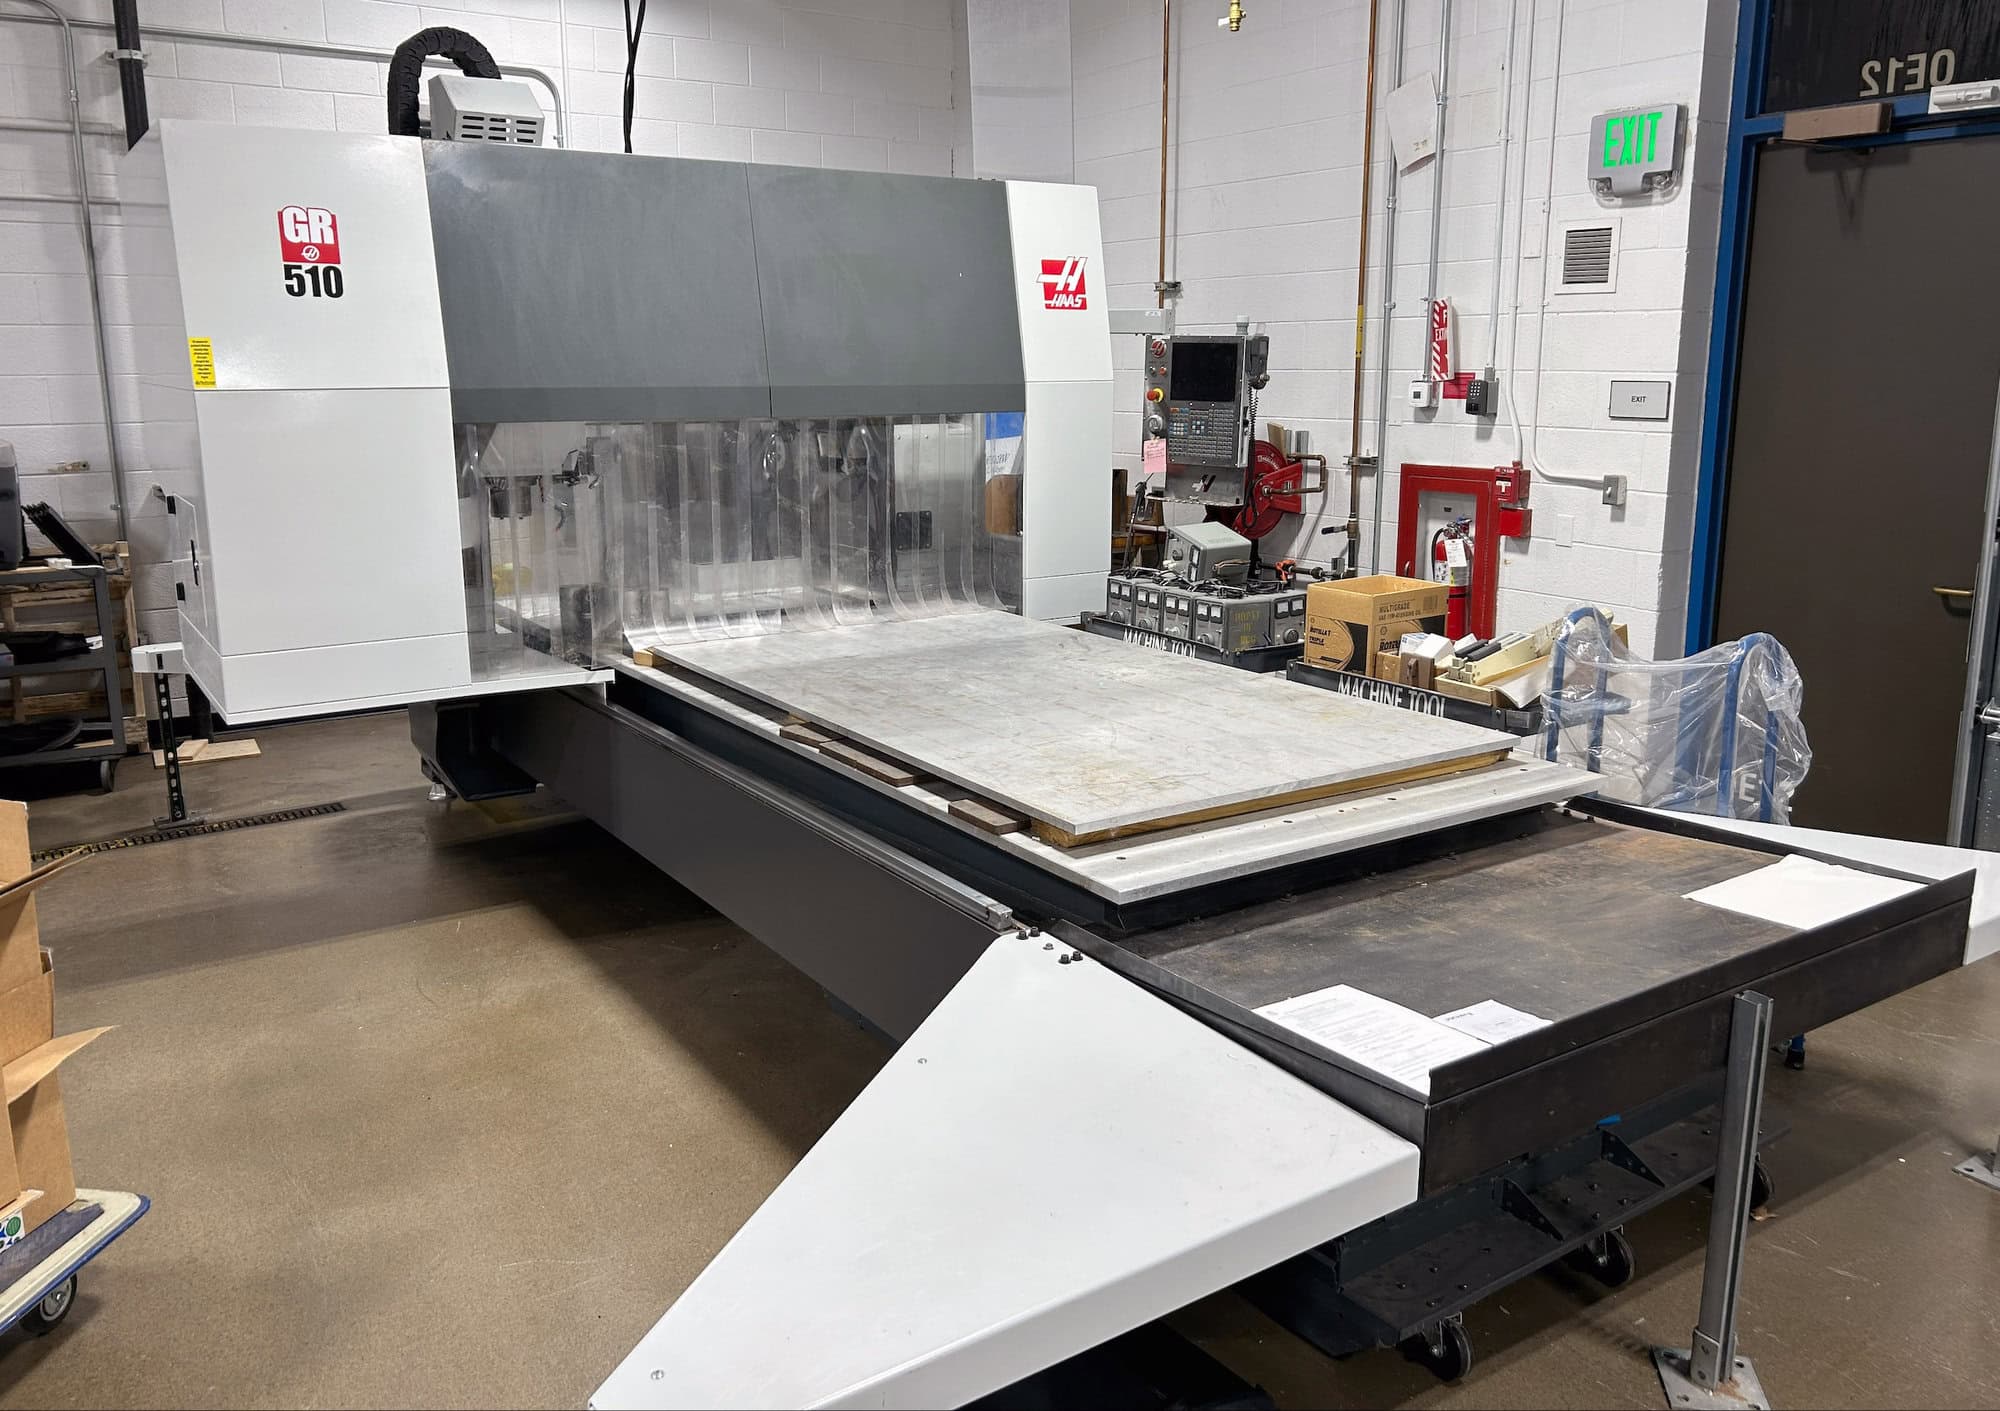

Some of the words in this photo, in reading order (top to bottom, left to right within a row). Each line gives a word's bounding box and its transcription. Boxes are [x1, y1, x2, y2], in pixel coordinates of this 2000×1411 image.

[1603, 112, 1663, 168] EXIT
[282, 206, 335, 244] GR
[283, 263, 344, 298] 510
[1044, 293, 1086, 307] HAAS
[1631, 395, 1647, 403] EXIT
[1123, 628, 1168, 652] MACHINE
[1338, 674, 1403, 708] MACHINE
